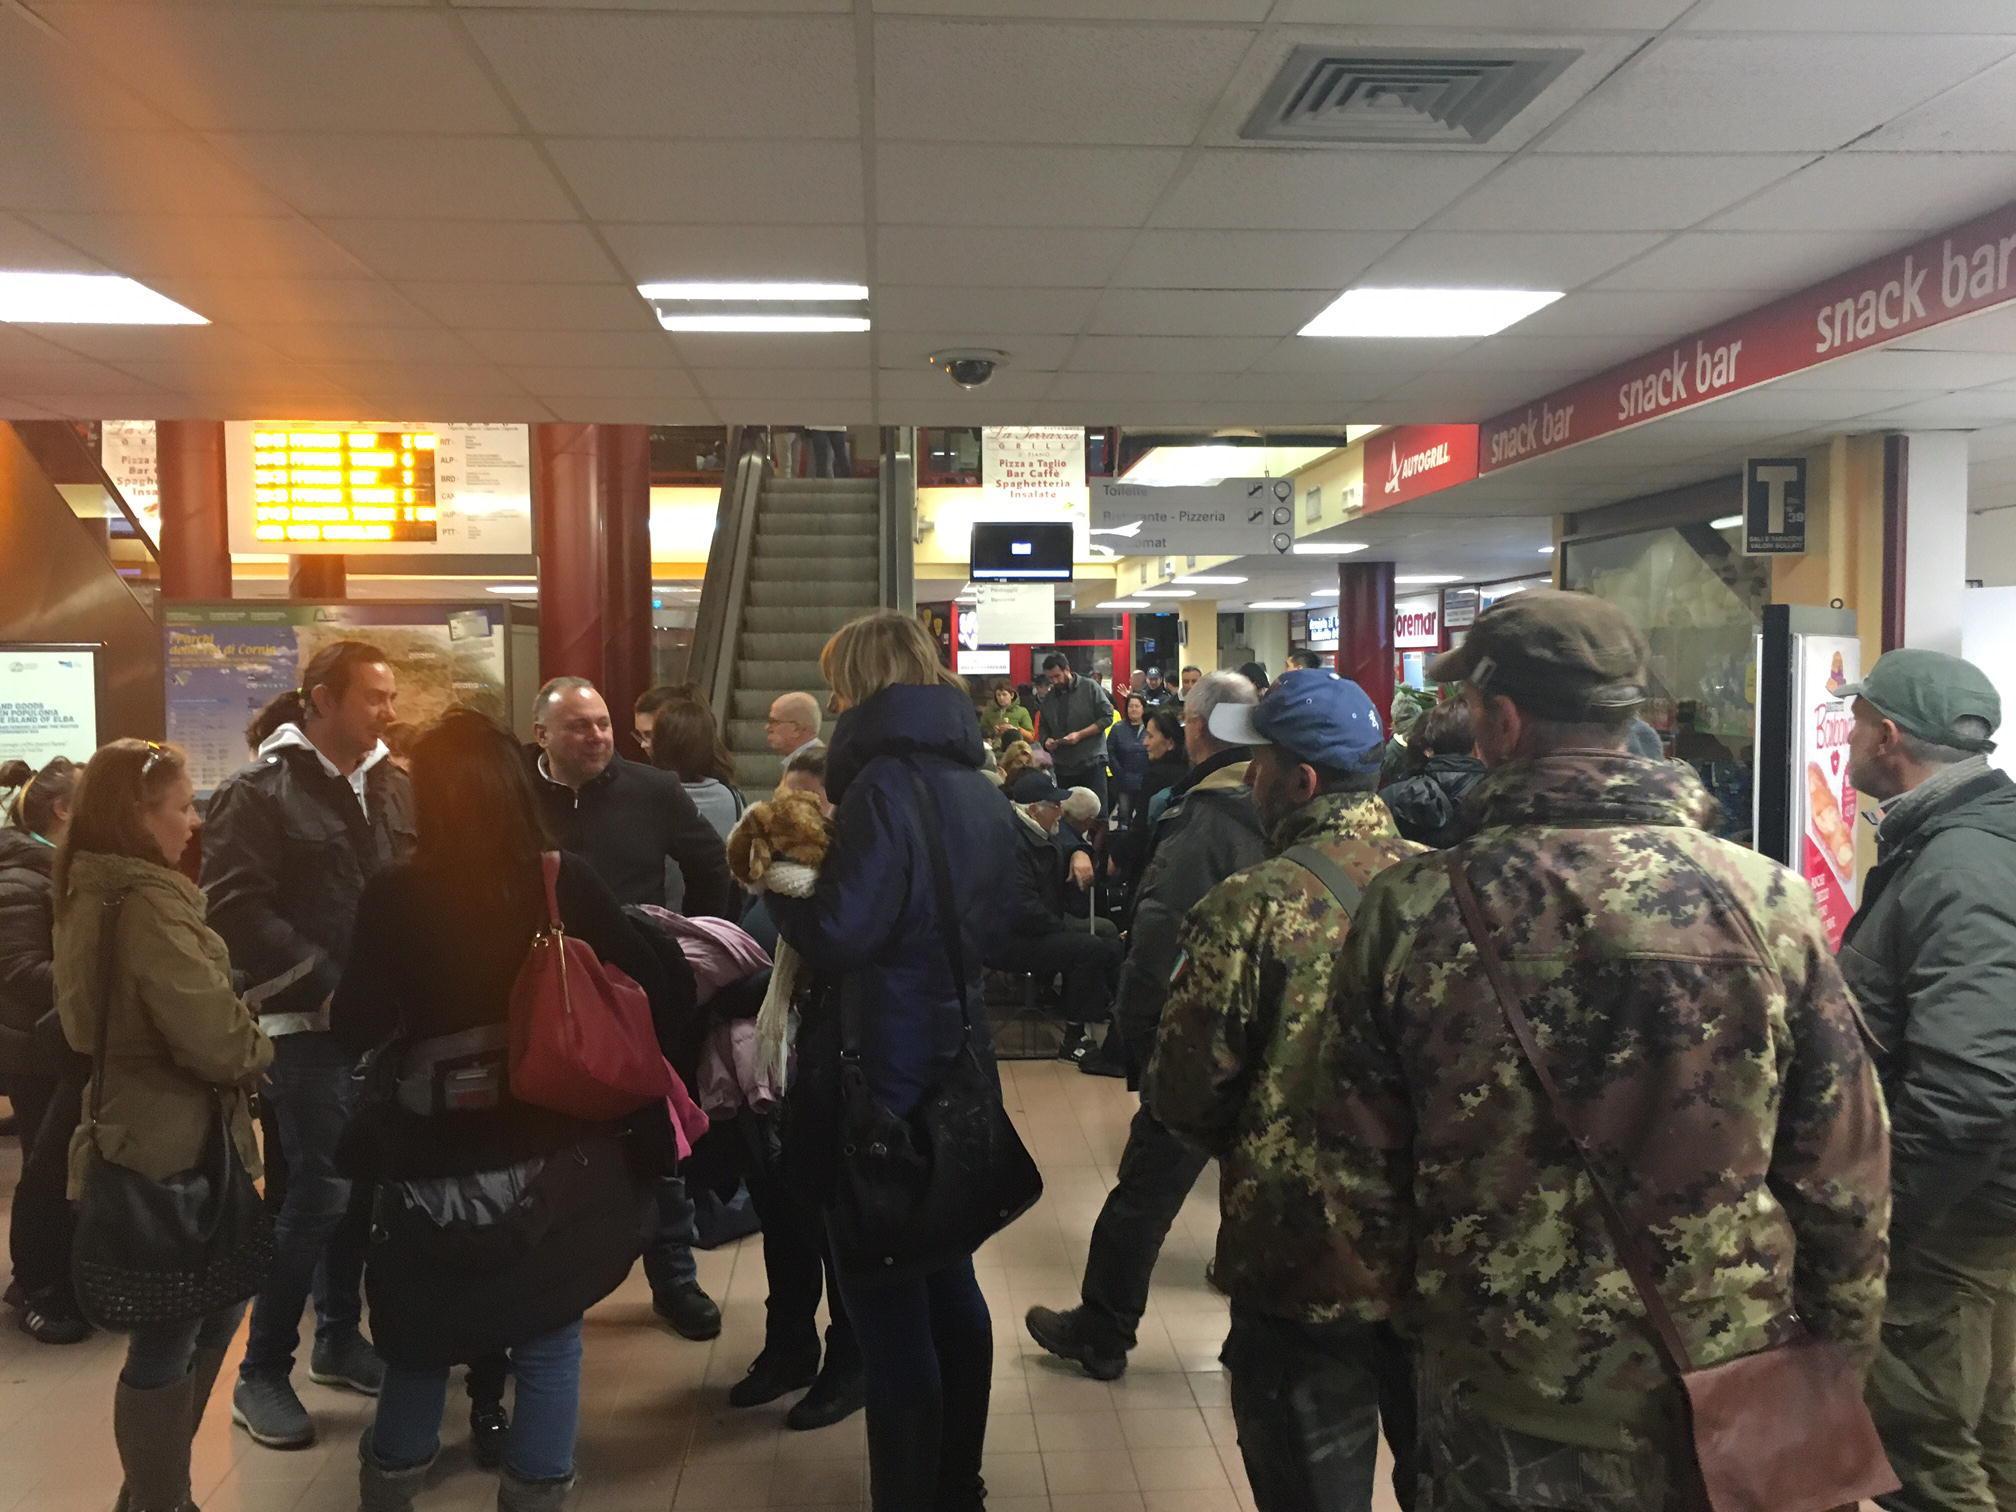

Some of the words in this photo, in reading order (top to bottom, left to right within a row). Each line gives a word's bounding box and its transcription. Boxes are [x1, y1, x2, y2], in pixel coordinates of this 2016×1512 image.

[1815, 254, 1929, 354] snack
[1941, 233, 2016, 309] bar
[1617, 349, 1689, 421] snack
[1695, 339, 1743, 394] bar
[1491, 408, 1538, 464] snack
[1541, 402, 1574, 444] bar
[121, 456, 150, 464] Pizza
[440, 456, 454, 464] ALP
[999, 459, 1026, 468] Pizza
[1037, 459, 1067, 469] Taglio
[1401, 442, 1450, 480] AUTOGRILL
[128, 467, 149, 475] Bar
[1006, 469, 1025, 478] Bar
[1029, 469, 1060, 478] Caffè
[995, 480, 1071, 490] Spaghetteria
[1010, 490, 1057, 499] Insalate
[1756, 465, 1798, 534] T
[1179, 510, 1226, 522] Pizzeria
[1395, 610, 1437, 638] oremar
[53, 715, 75, 723] ELBA
